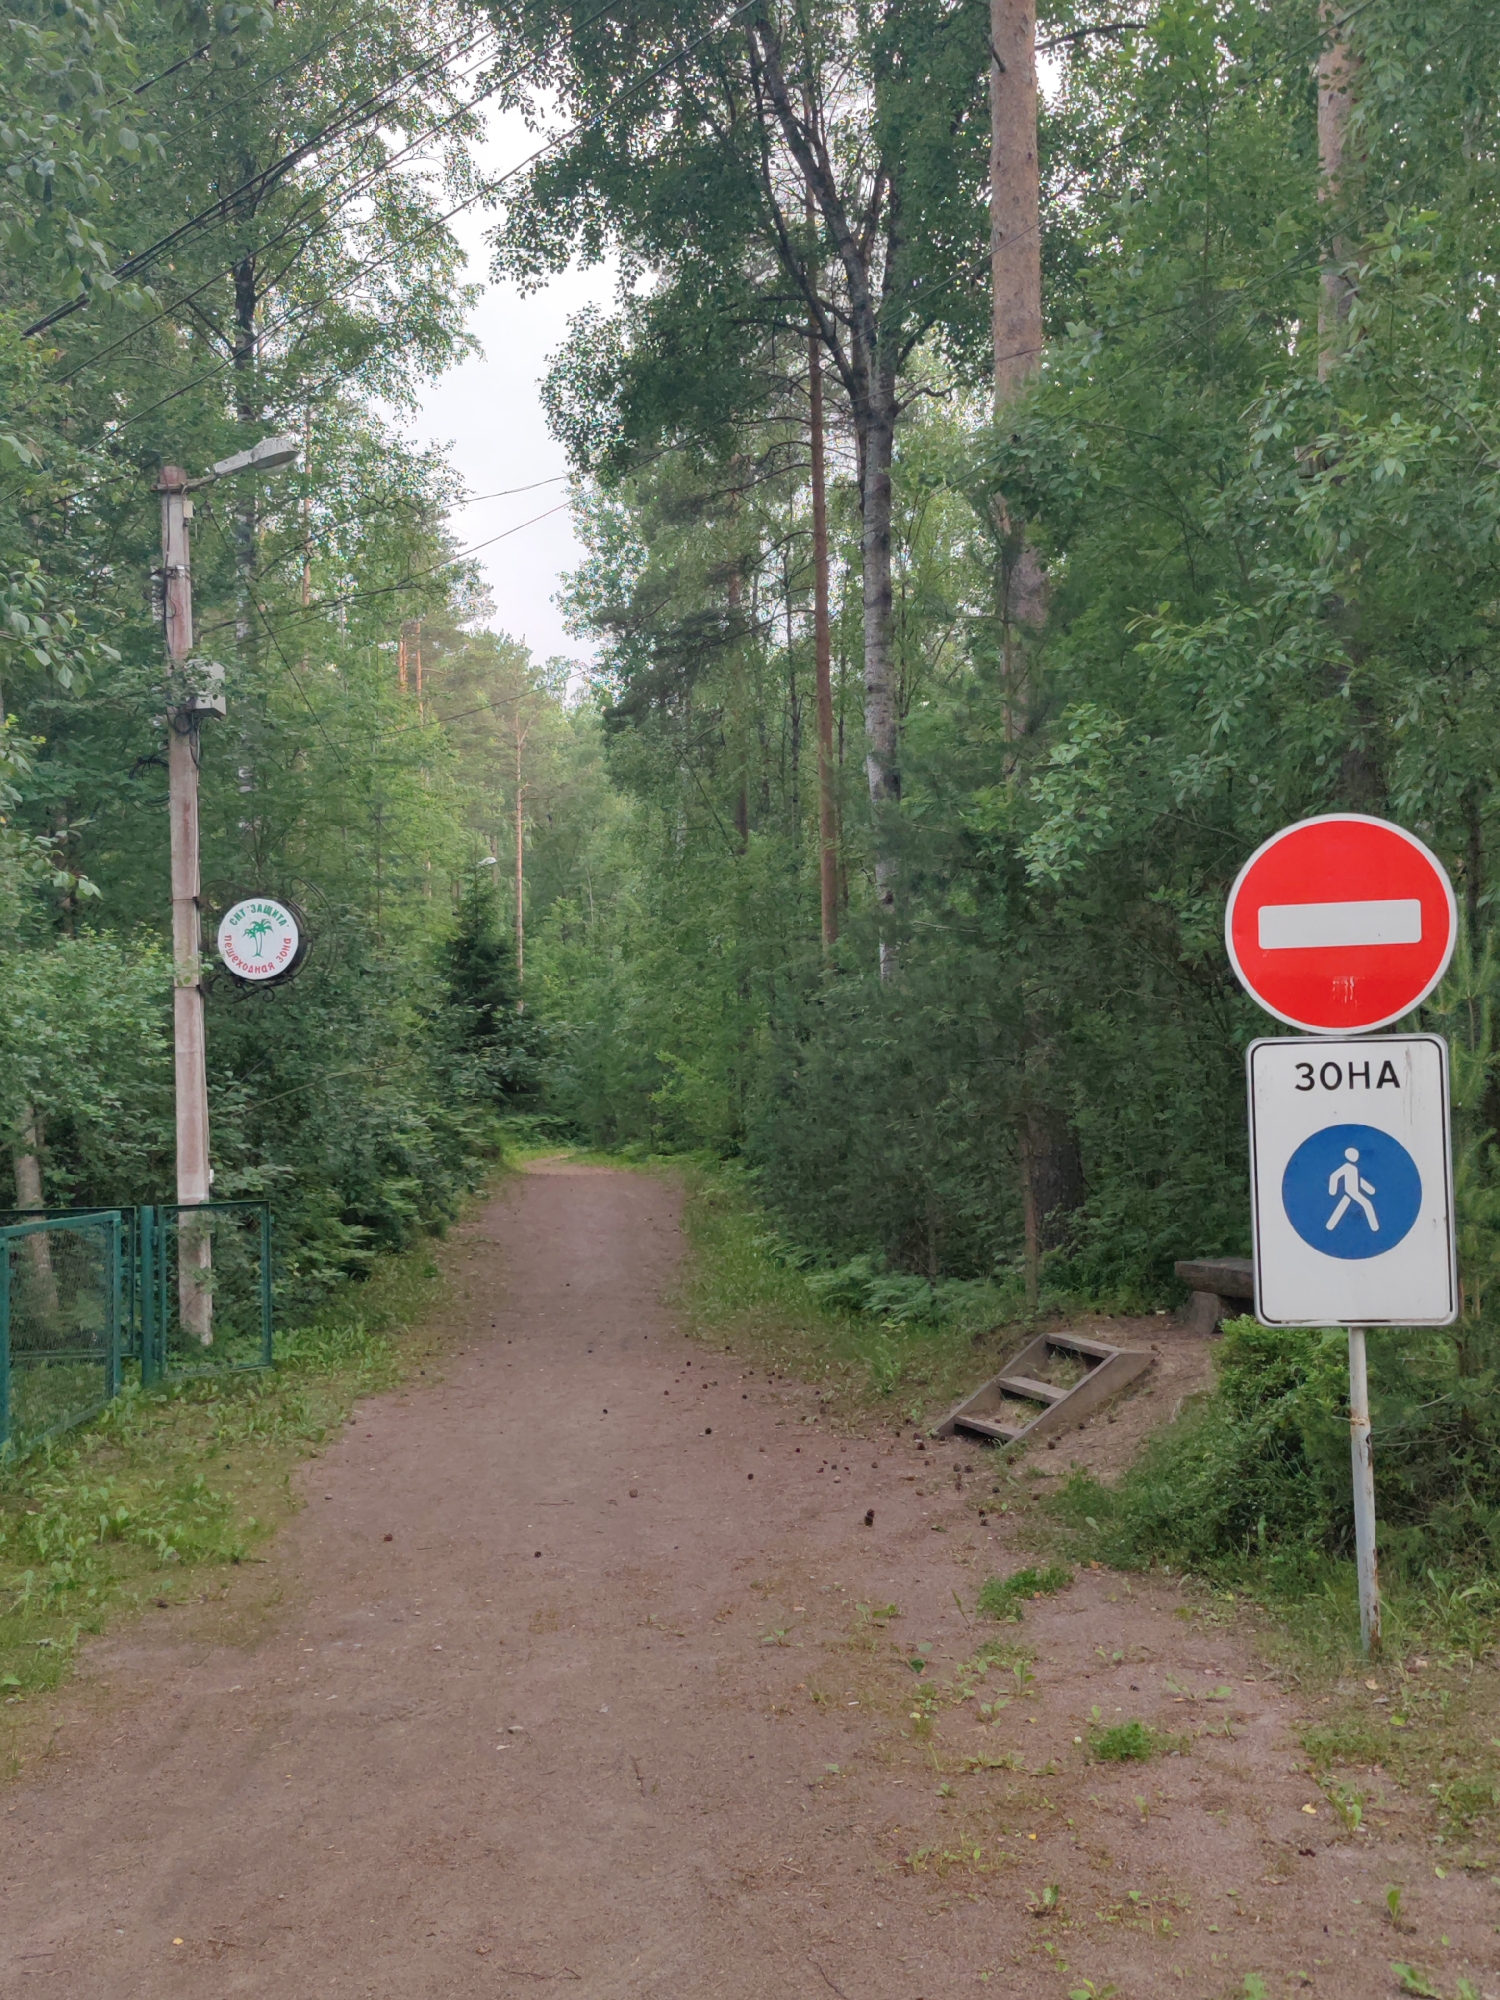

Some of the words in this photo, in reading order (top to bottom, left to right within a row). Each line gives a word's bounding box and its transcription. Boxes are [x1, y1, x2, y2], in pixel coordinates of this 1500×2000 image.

[229, 908, 246, 926] СНТ
[224, 935, 275, 974] пешеходная
[276, 938, 292, 963] зона
[1295, 1060, 1401, 1091] ЗОНА
